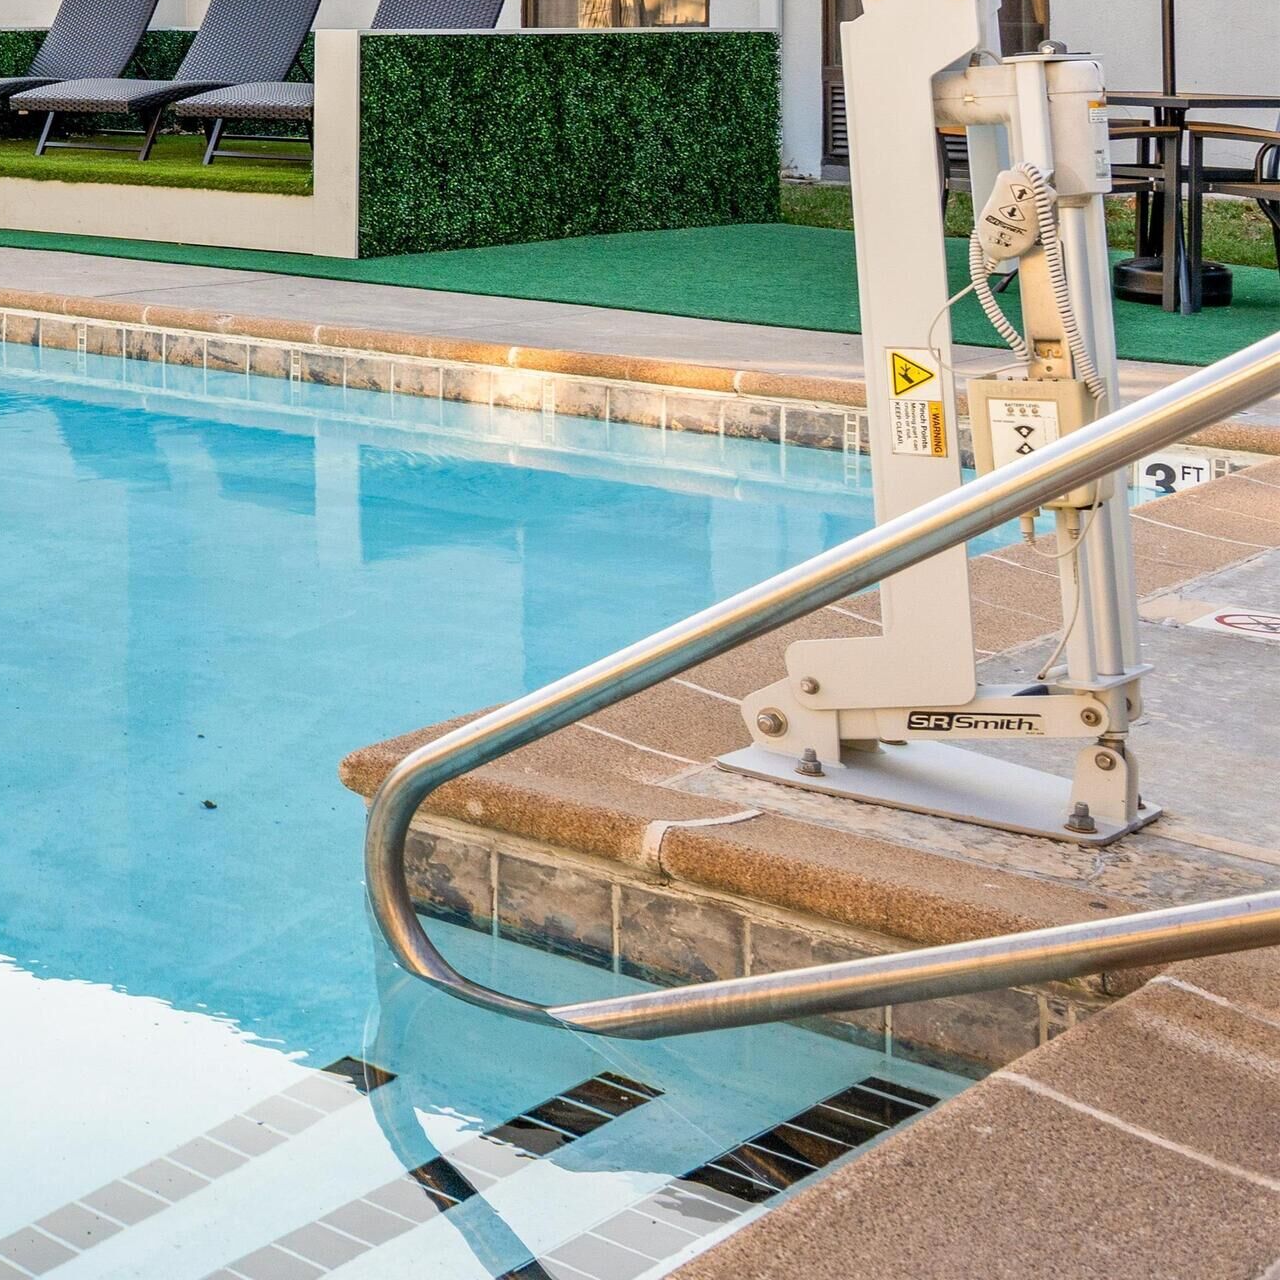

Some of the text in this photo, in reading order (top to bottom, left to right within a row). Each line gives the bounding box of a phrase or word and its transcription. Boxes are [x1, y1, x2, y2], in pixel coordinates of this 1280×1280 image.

[919, 403, 927, 424] Pinch
[932, 413, 943, 453] WARNING
[1145, 463, 1204, 494] 3 FT
[909, 714, 1034, 731] SR Smith
